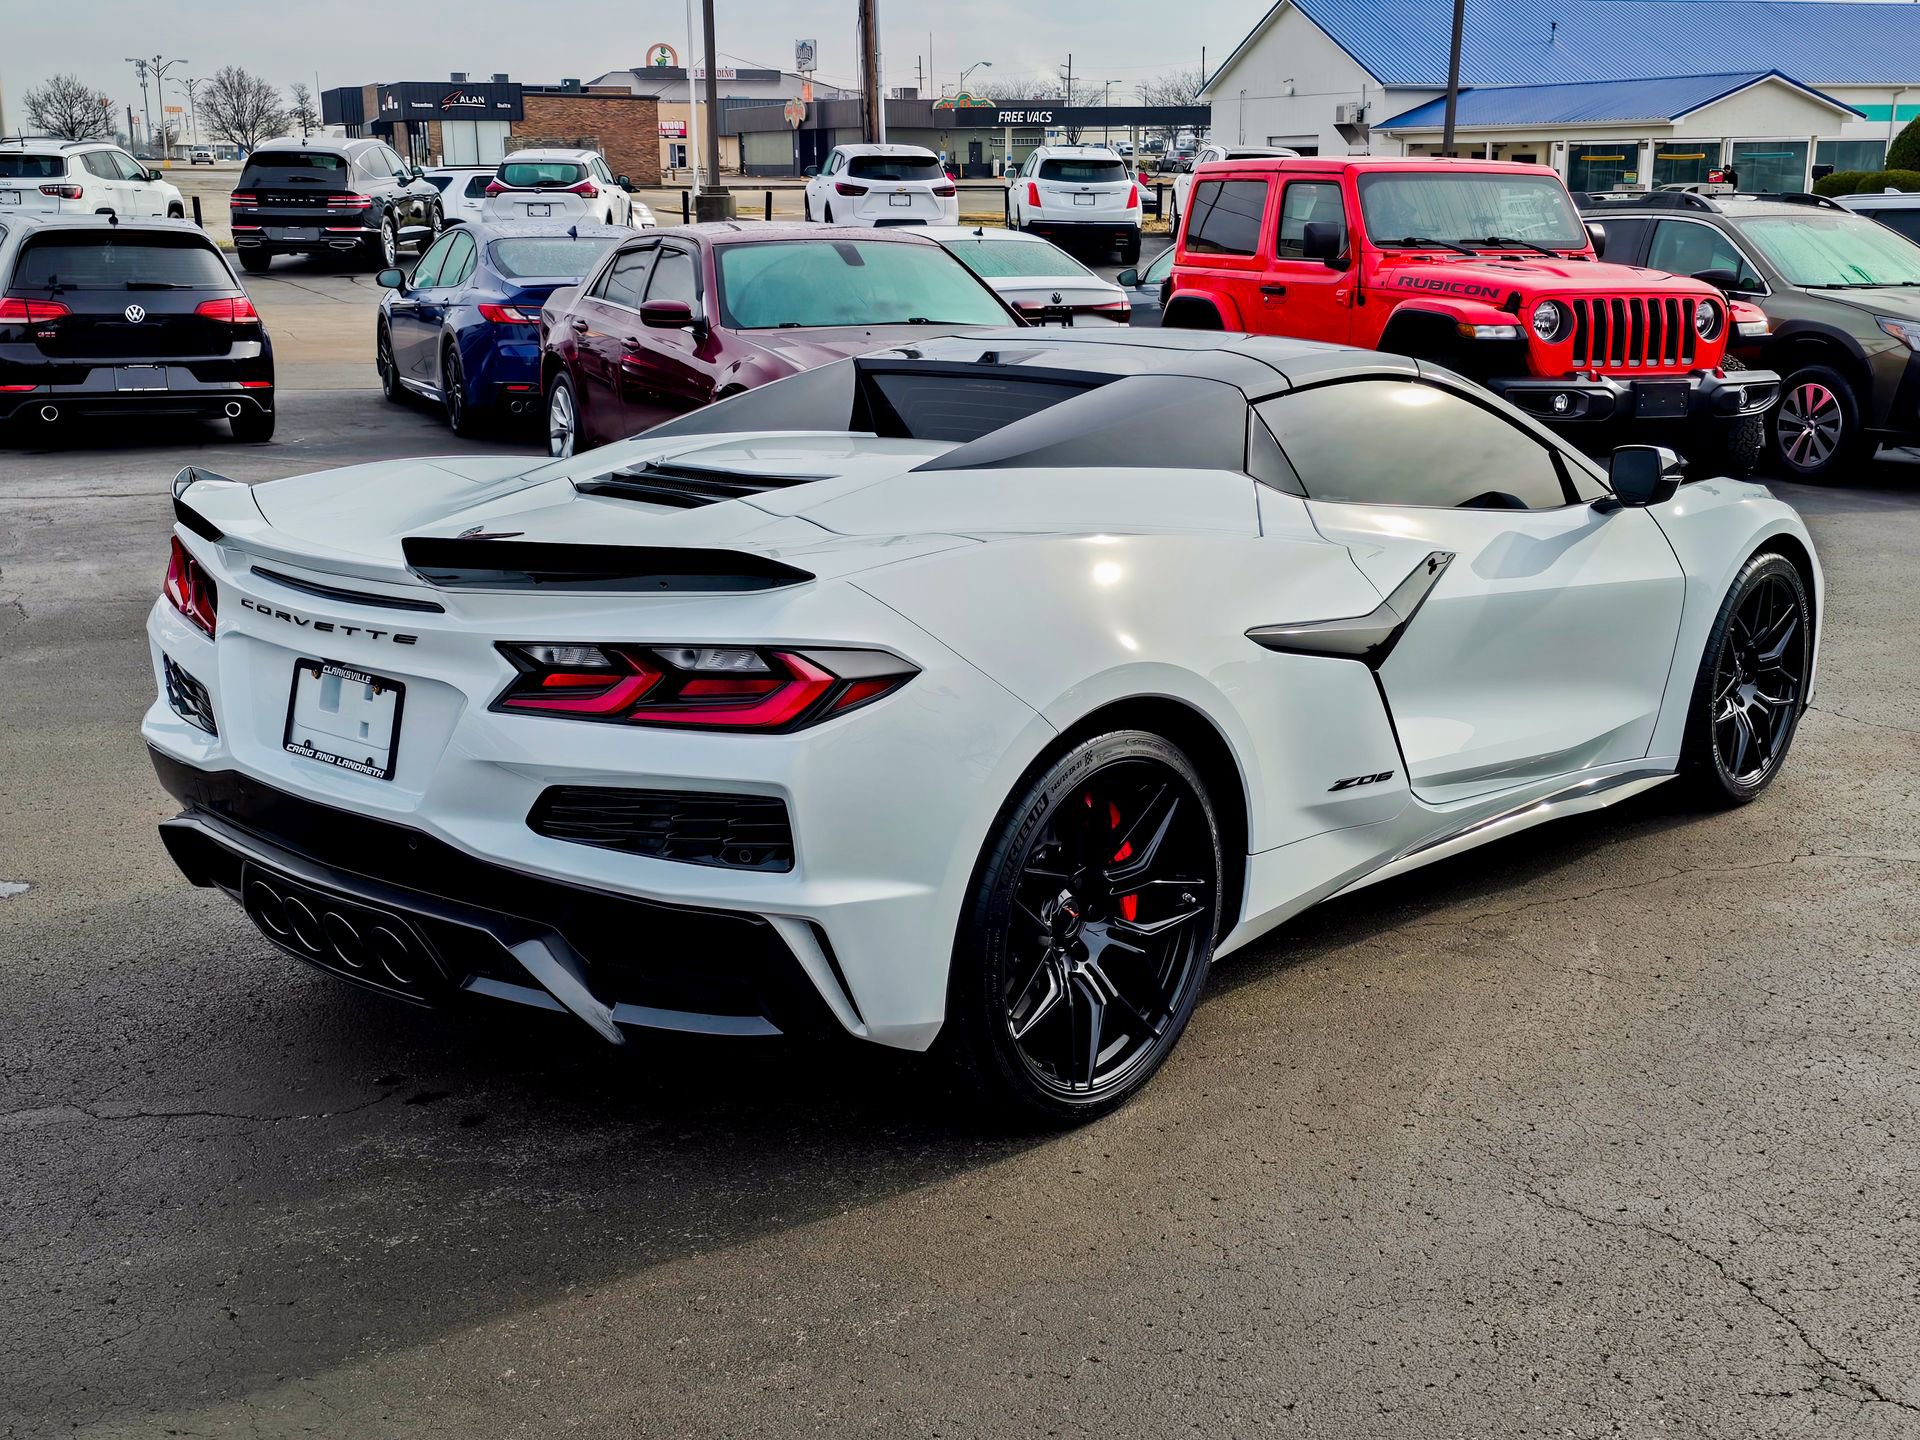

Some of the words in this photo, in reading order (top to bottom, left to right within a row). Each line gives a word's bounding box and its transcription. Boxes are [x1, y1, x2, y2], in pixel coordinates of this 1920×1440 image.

[460, 95, 485, 104] ALAN
[998, 111, 1024, 123] FREE
[1027, 111, 1053, 123] VACS
[1398, 276, 1501, 298] RUBICON
[240, 597, 419, 645] CORVETTE
[322, 665, 372, 684] CLARKSVILLE
[315, 751, 336, 763] AND
[336, 757, 385, 778] LANDRETH
[1327, 770, 1394, 791] Z06
[1000, 792, 1049, 886] MICHELIN
